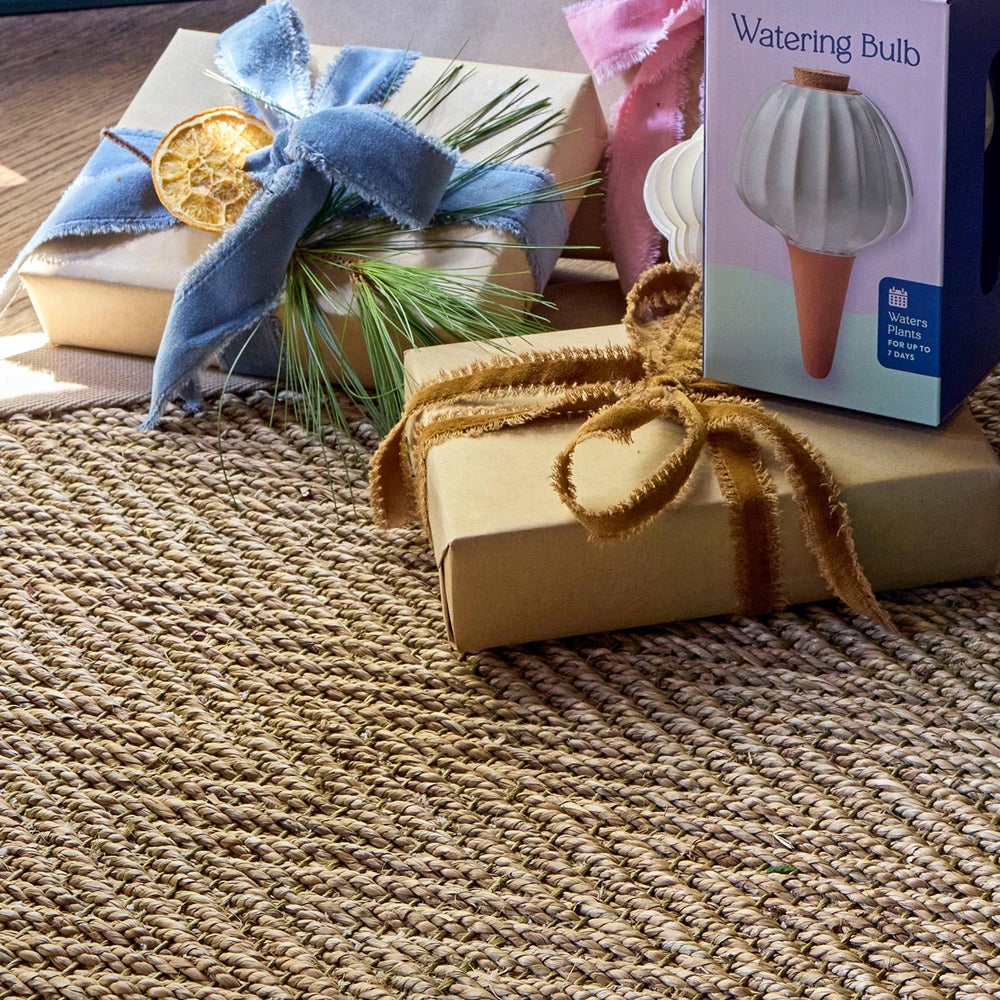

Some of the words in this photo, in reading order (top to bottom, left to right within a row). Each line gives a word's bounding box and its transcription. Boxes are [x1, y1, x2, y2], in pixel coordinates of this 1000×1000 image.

[731, 13, 852, 63] Watering
[861, 32, 921, 67] Bulb
[888, 311, 928, 328] Waters
[888, 324, 922, 340] Plants
[888, 339, 905, 348] FOR
[906, 343, 918, 351] UP
[920, 345, 931, 353] TO
[894, 351, 915, 361] DAYS
